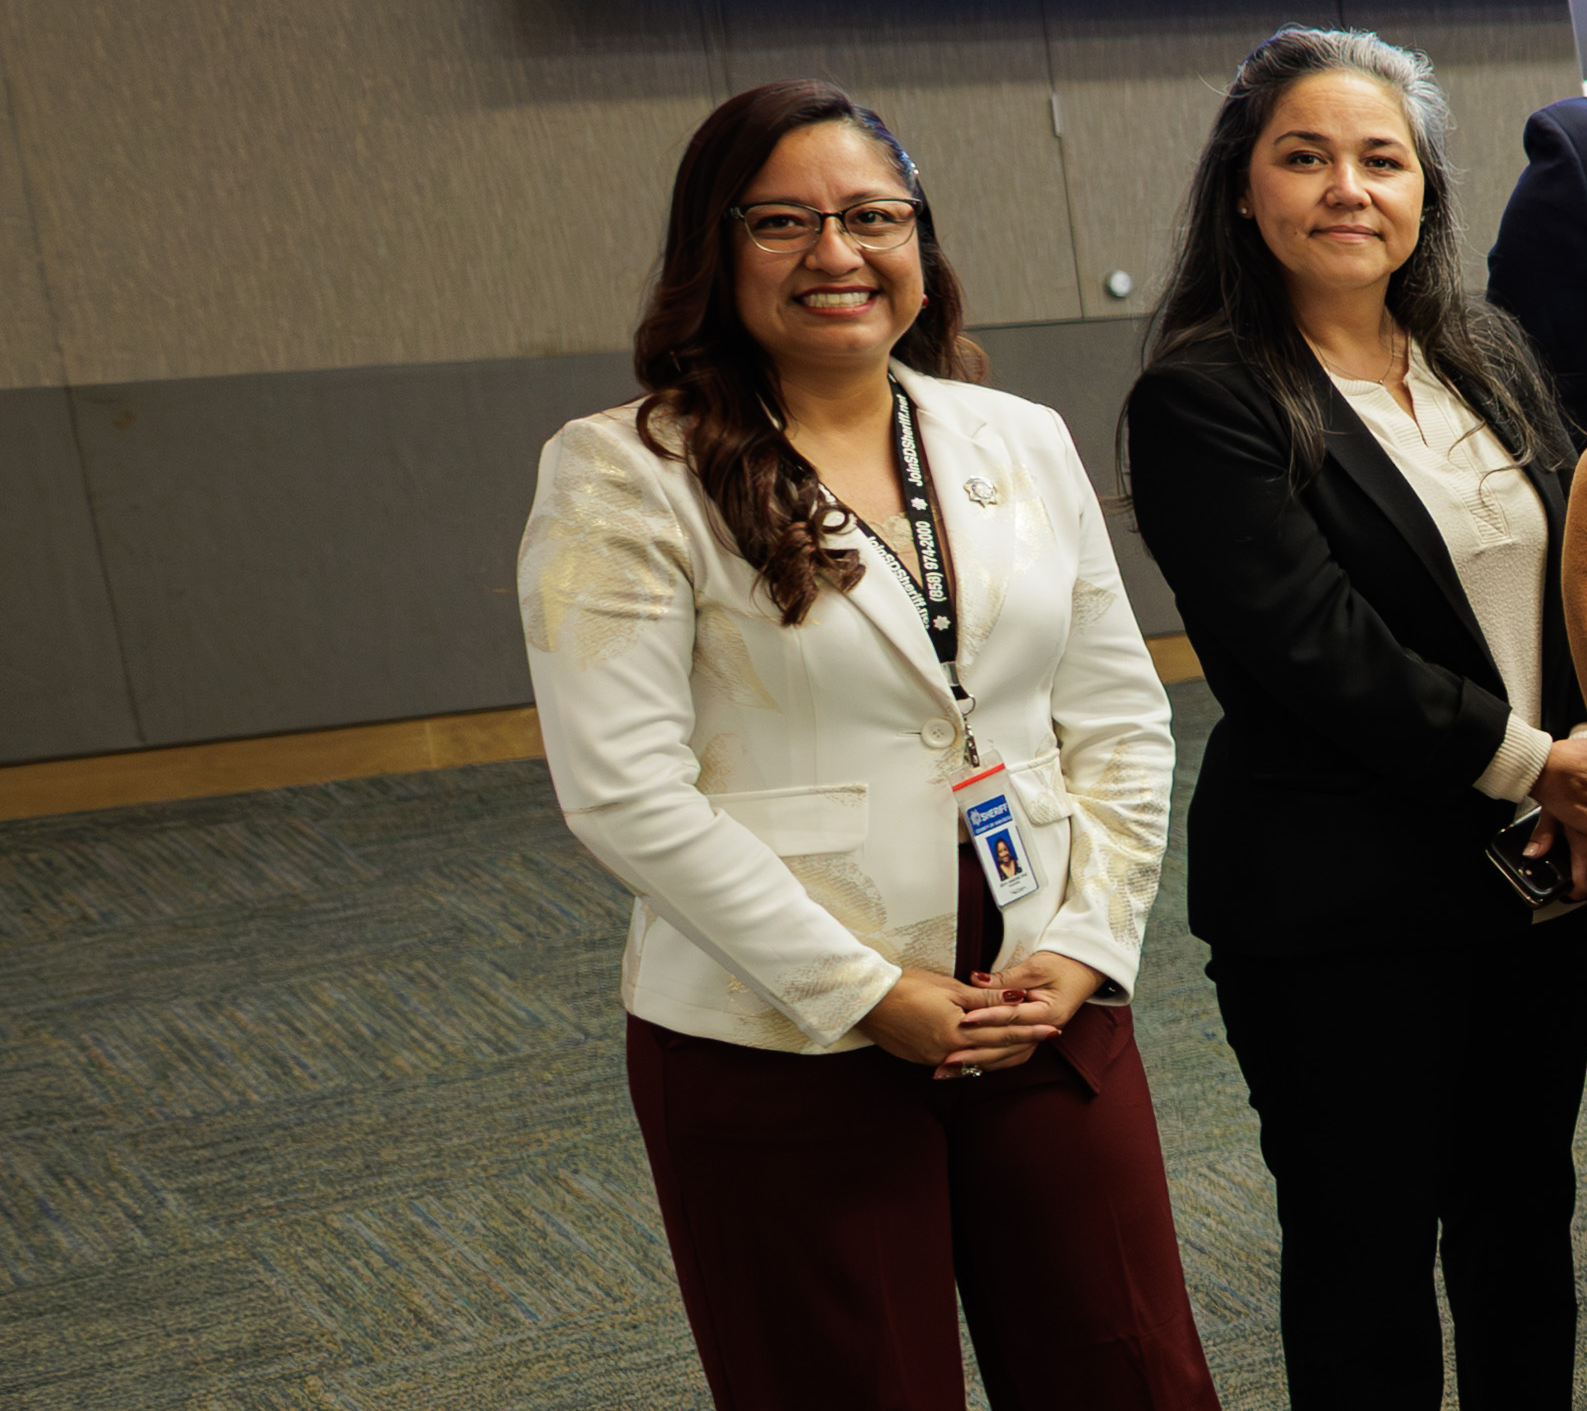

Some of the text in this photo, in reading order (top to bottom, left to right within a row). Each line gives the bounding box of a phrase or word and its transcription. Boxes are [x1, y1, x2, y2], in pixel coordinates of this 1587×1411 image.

[896, 393, 923, 487] JoinSDSheriff.net
[915, 520, 948, 603] (858) 974-2000
